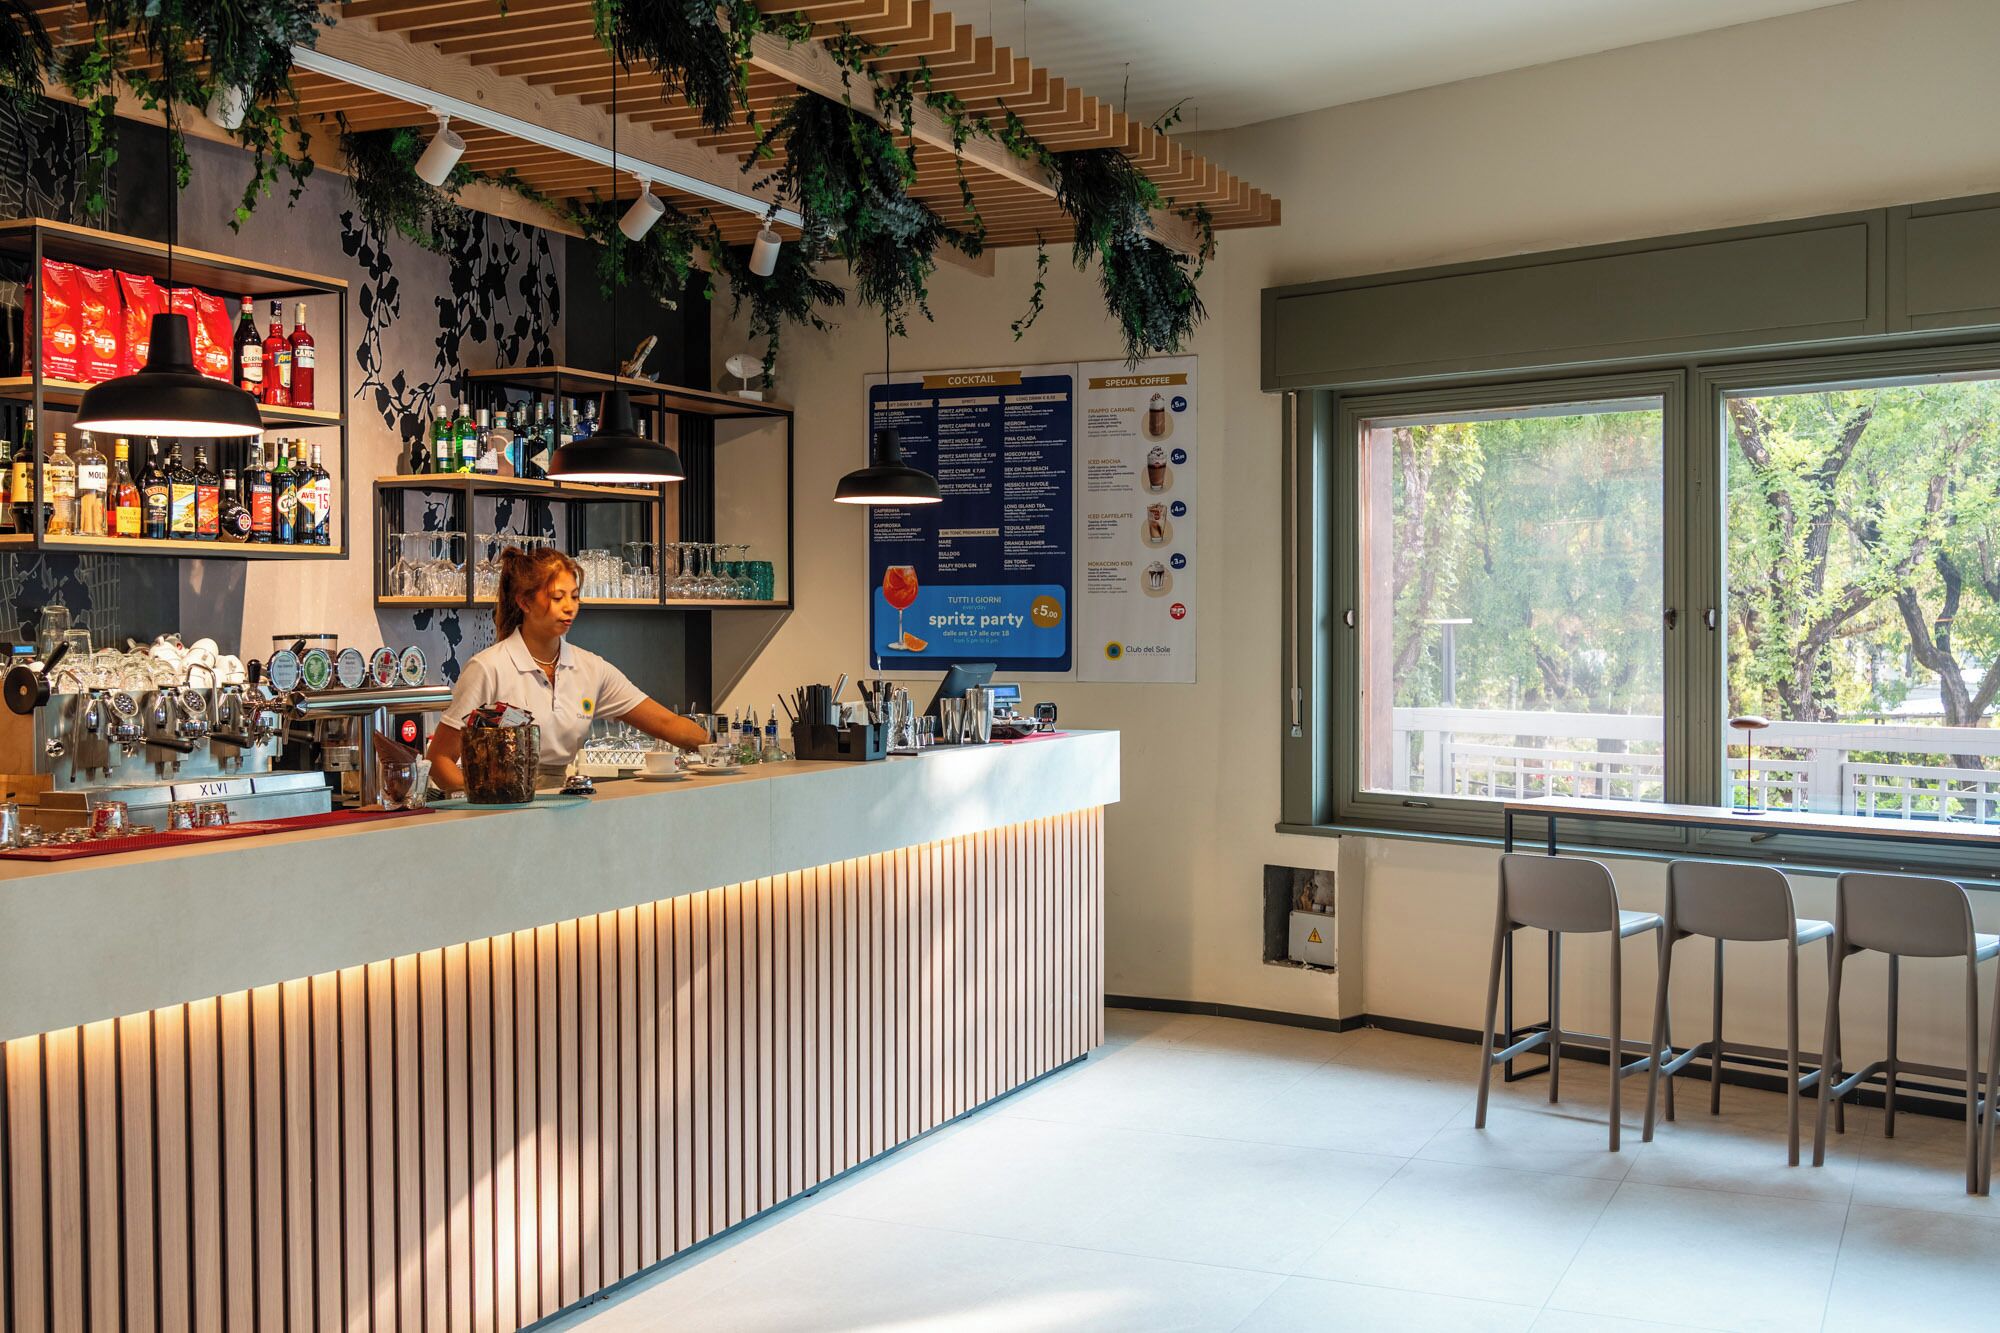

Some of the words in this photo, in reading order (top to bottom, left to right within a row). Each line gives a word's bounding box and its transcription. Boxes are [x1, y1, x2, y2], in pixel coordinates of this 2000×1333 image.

[947, 375, 996, 385] COCKTAIL
[1105, 378, 1139, 387] SPECIAL
[1139, 376, 1170, 385] COFFEE
[277, 493, 298, 513] CYNA
[317, 493, 330, 509] 15
[948, 596, 970, 604] TUTTI
[975, 596, 1002, 604] GIORNI
[1033, 607, 1038, 615] €
[928, 611, 975, 628] spritz
[980, 612, 1024, 629] party
[1125, 645, 1142, 653] Club
[1143, 645, 1154, 653] del
[1155, 645, 1171, 653] Sole
[199, 782, 229, 797] XLVI
